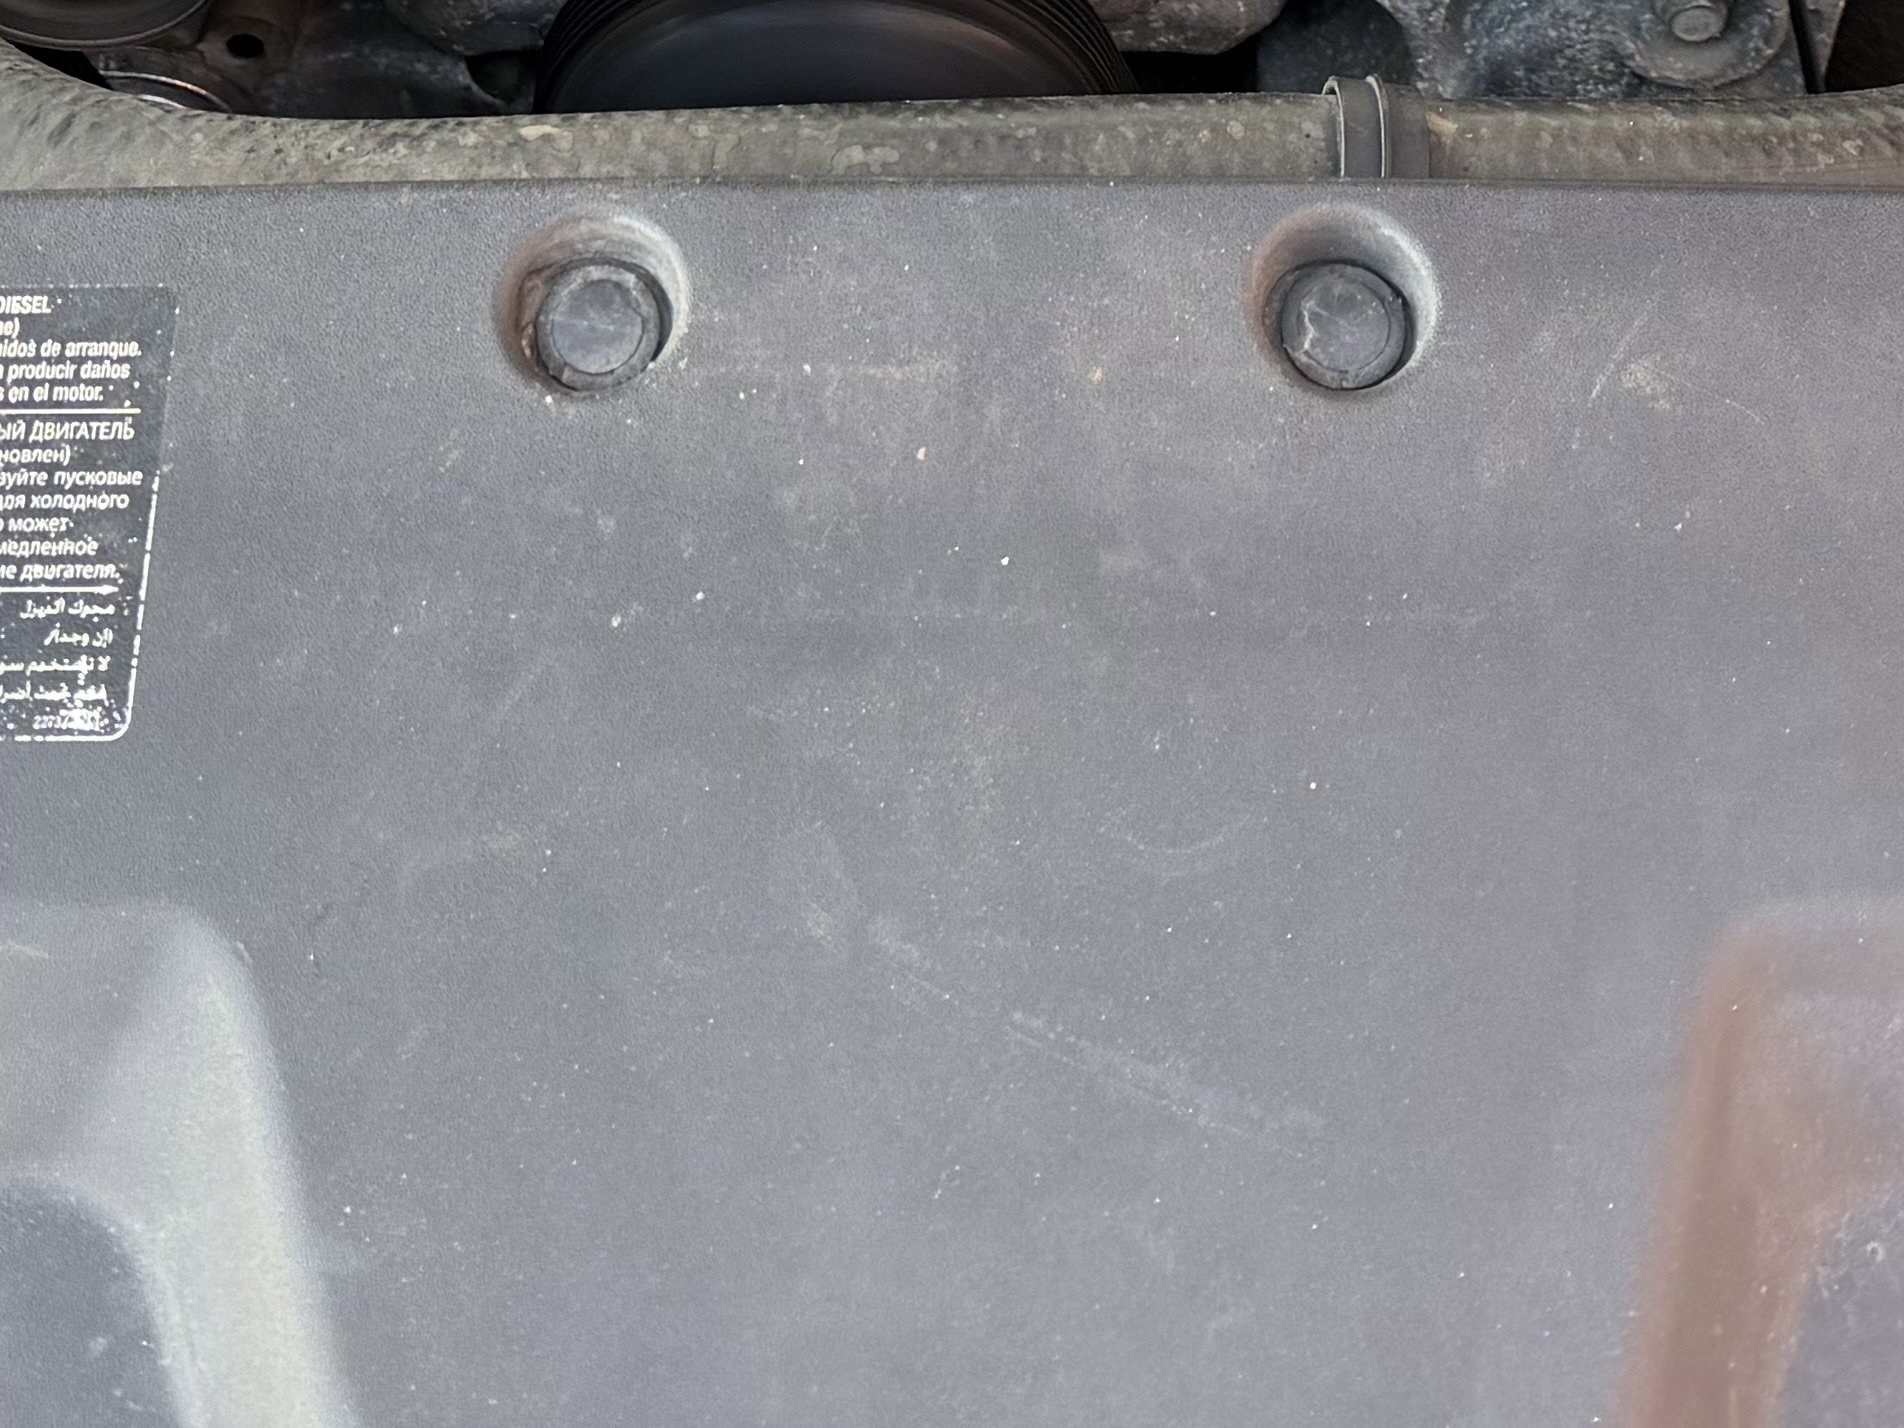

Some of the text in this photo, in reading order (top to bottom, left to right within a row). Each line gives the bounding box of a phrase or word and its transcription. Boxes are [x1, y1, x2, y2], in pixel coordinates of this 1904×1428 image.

[40, 339, 60, 357] de
[65, 341, 142, 360] arranque.
[7, 359, 77, 384] producir
[80, 360, 130, 379] daños
[8, 386, 29, 402] en
[33, 383, 49, 401] el
[53, 384, 103, 402] motor.
[29, 419, 136, 442] ДВИГАТЕЛЬ
[53, 471, 144, 489] пусковые
[30, 492, 130, 512] холодного
[8, 518, 71, 532] может
[20, 564, 120, 582] двигателя.
